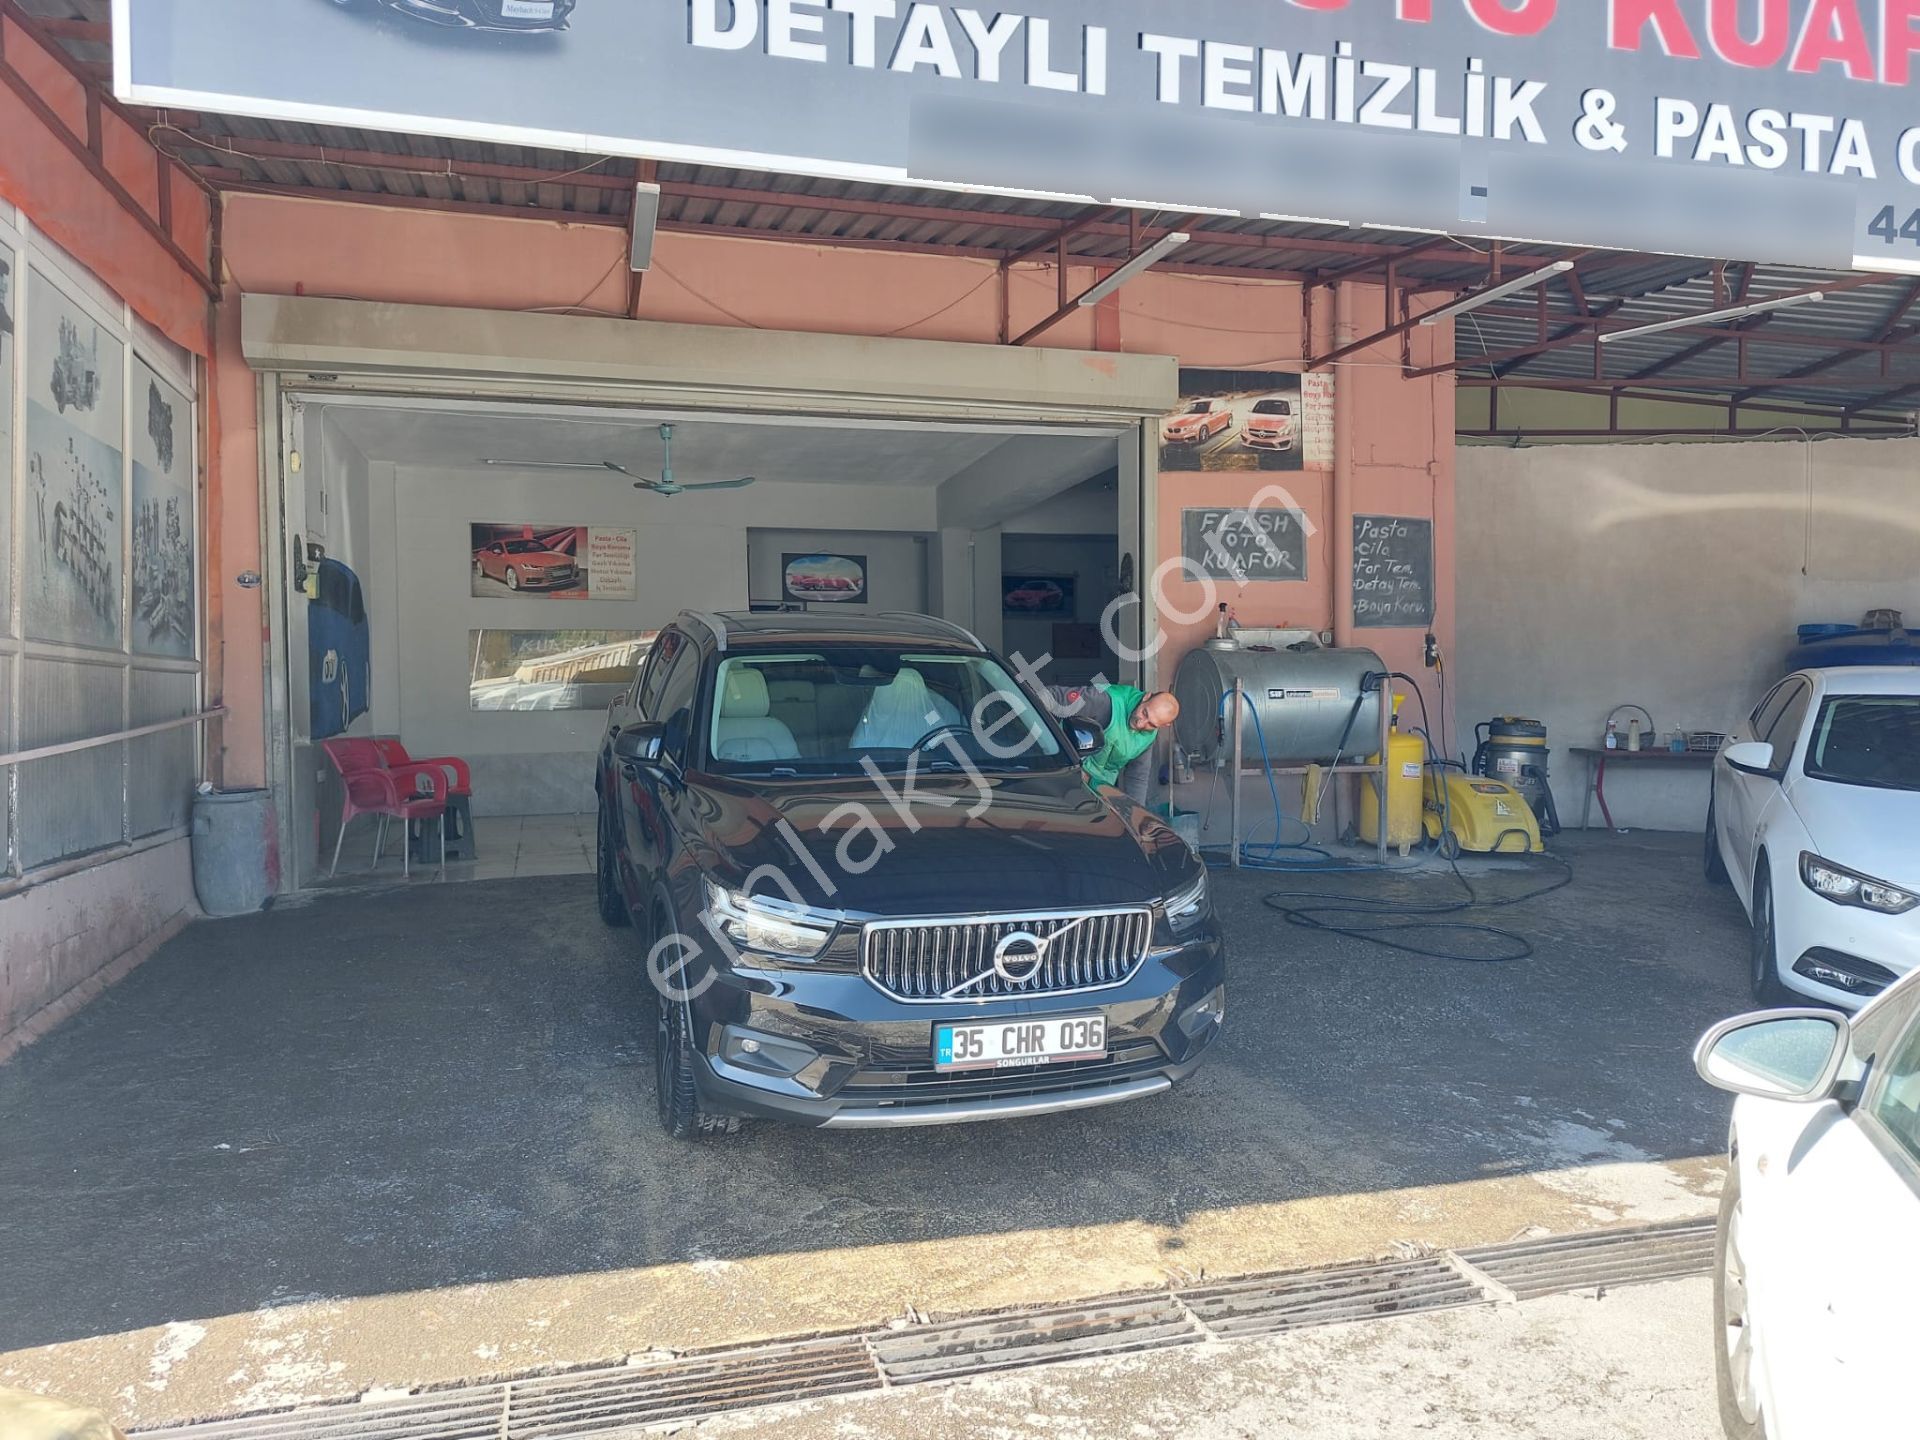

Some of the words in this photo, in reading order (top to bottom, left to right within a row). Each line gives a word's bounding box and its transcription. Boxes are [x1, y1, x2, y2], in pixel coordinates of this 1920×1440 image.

[687, 0, 1107, 95] DETAYLI
[1138, 32, 1548, 144] TEMİZLİK
[1572, 87, 1628, 153] &
[1654, 96, 1877, 179] PASTA
[1200, 512, 1289, 533] FLASH
[1358, 519, 1408, 539] Pasta
[1225, 533, 1267, 547] OTO
[1356, 558, 1381, 574] Far
[1355, 574, 1395, 595] Detay
[1003, 954, 1037, 962] VOLVO
[940, 1048, 951, 1057] TR
[954, 1029, 984, 1059] 35
[1001, 1024, 1046, 1055] CHR
[1060, 1020, 1103, 1050] 036
[996, 1056, 1050, 1068] SONGURLAR
